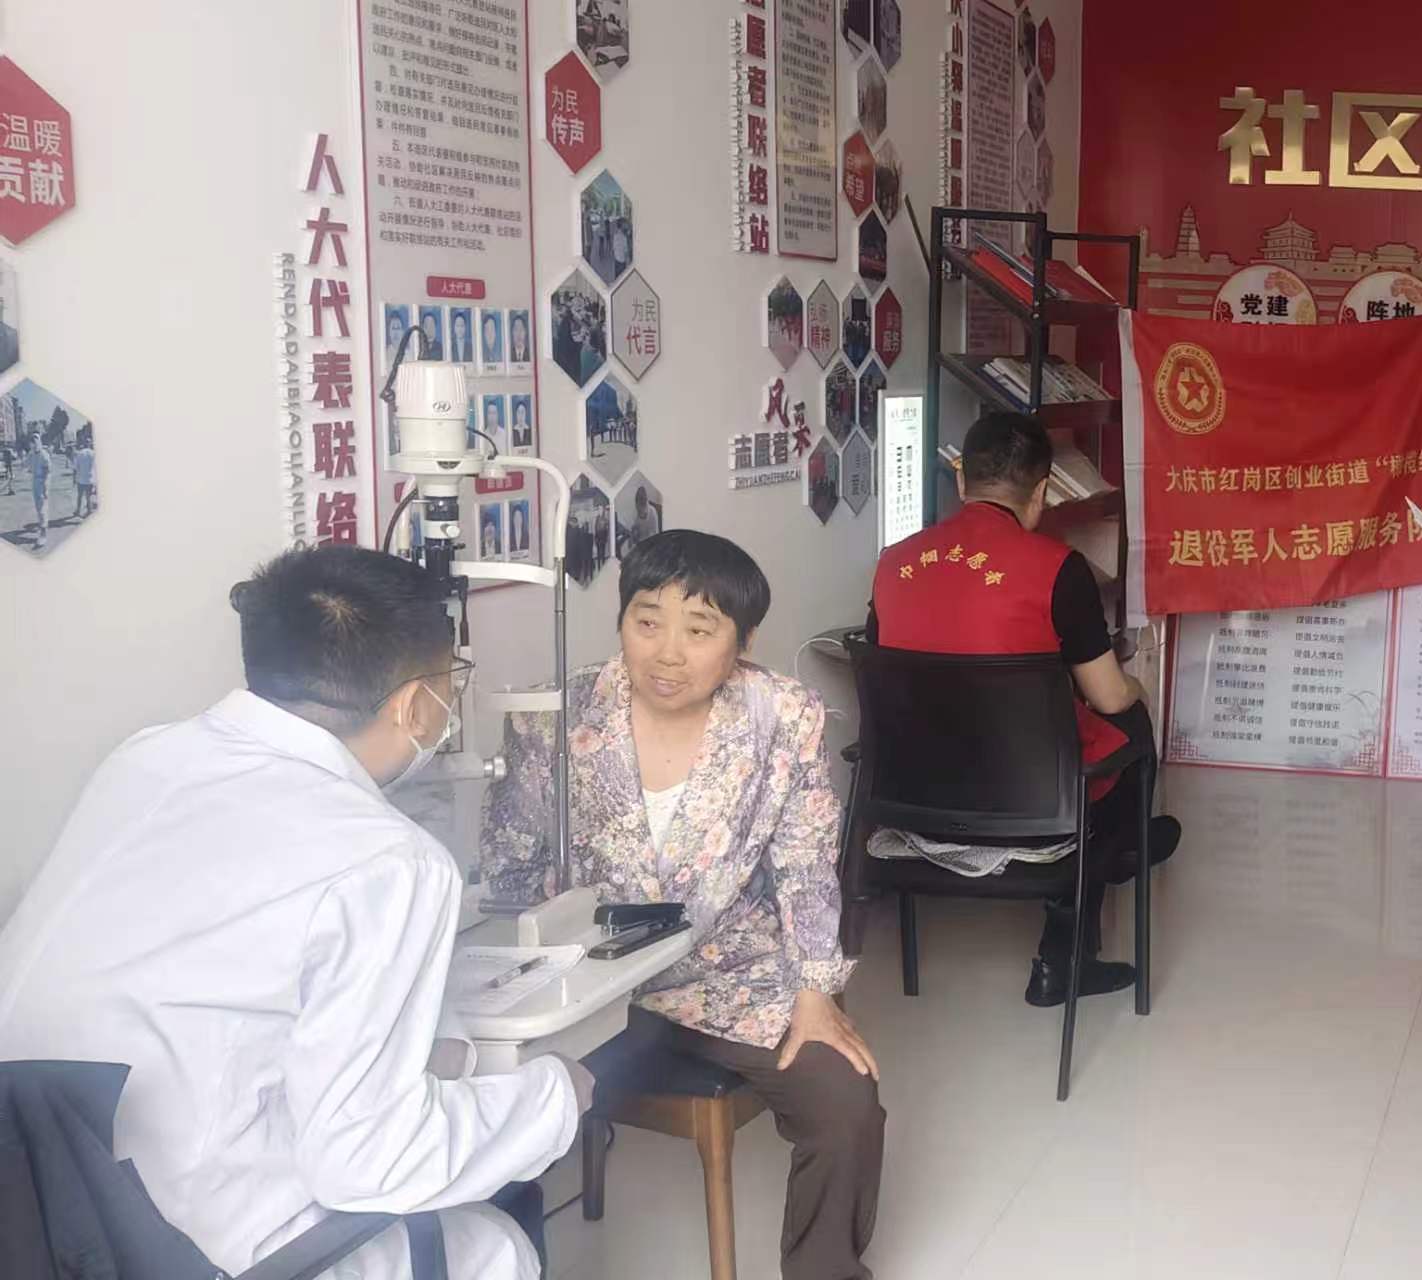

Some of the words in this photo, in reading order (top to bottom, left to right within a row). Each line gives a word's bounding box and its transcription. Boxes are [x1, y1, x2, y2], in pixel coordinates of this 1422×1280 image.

[551, 114, 585, 146] 传声
[1240, 293, 1290, 317] 党建
[1366, 301, 1415, 322] 阵地
[626, 326, 657, 355] 代言
